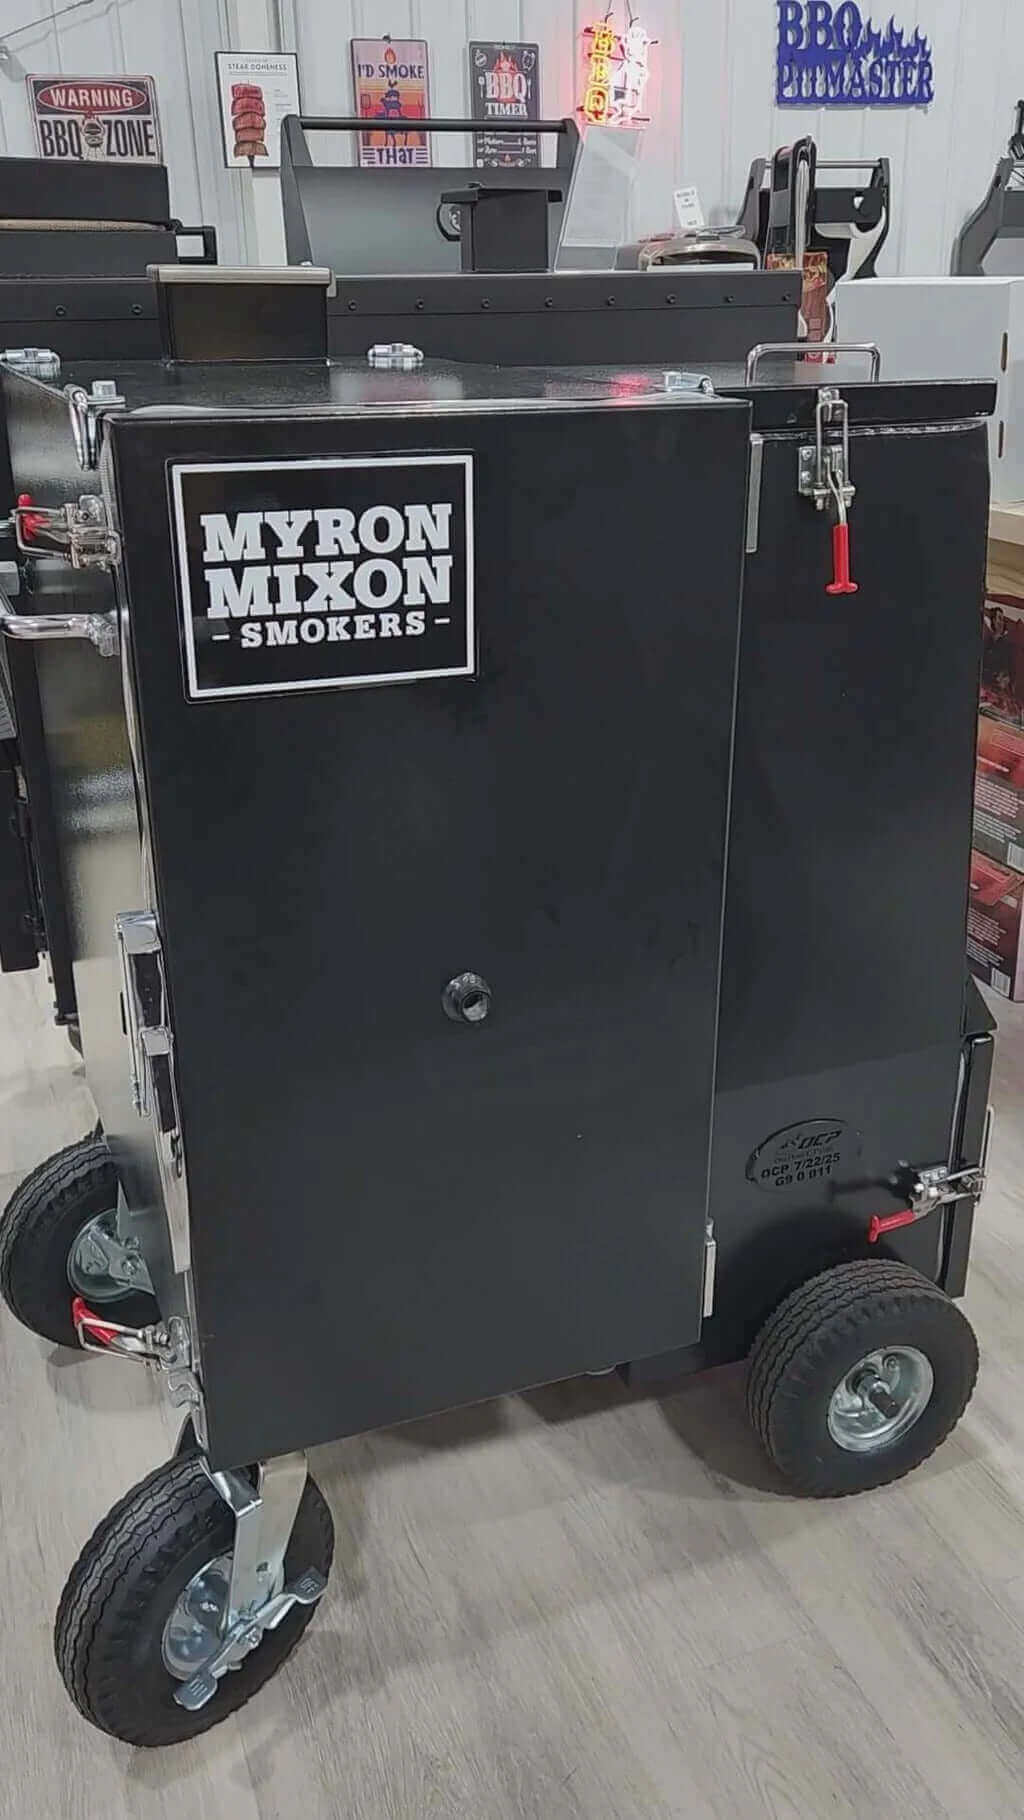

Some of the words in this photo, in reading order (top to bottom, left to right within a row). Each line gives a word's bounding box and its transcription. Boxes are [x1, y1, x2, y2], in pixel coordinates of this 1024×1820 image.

[777, 0, 862, 52] BBQ
[357, 64, 375, 78] I'D
[379, 64, 425, 79] SMOKE
[485, 72, 527, 103] BBQ
[777, 58, 934, 100] PITMASTER
[50, 88, 134, 107] WARNING
[485, 102, 528, 116] TIMER
[40, 119, 84, 159] BBQ
[104, 119, 156, 157] ZONE
[200, 502, 453, 563] MYRON
[204, 555, 454, 619] MIXON
[794, 1152, 841, 1171] 7/22/25
